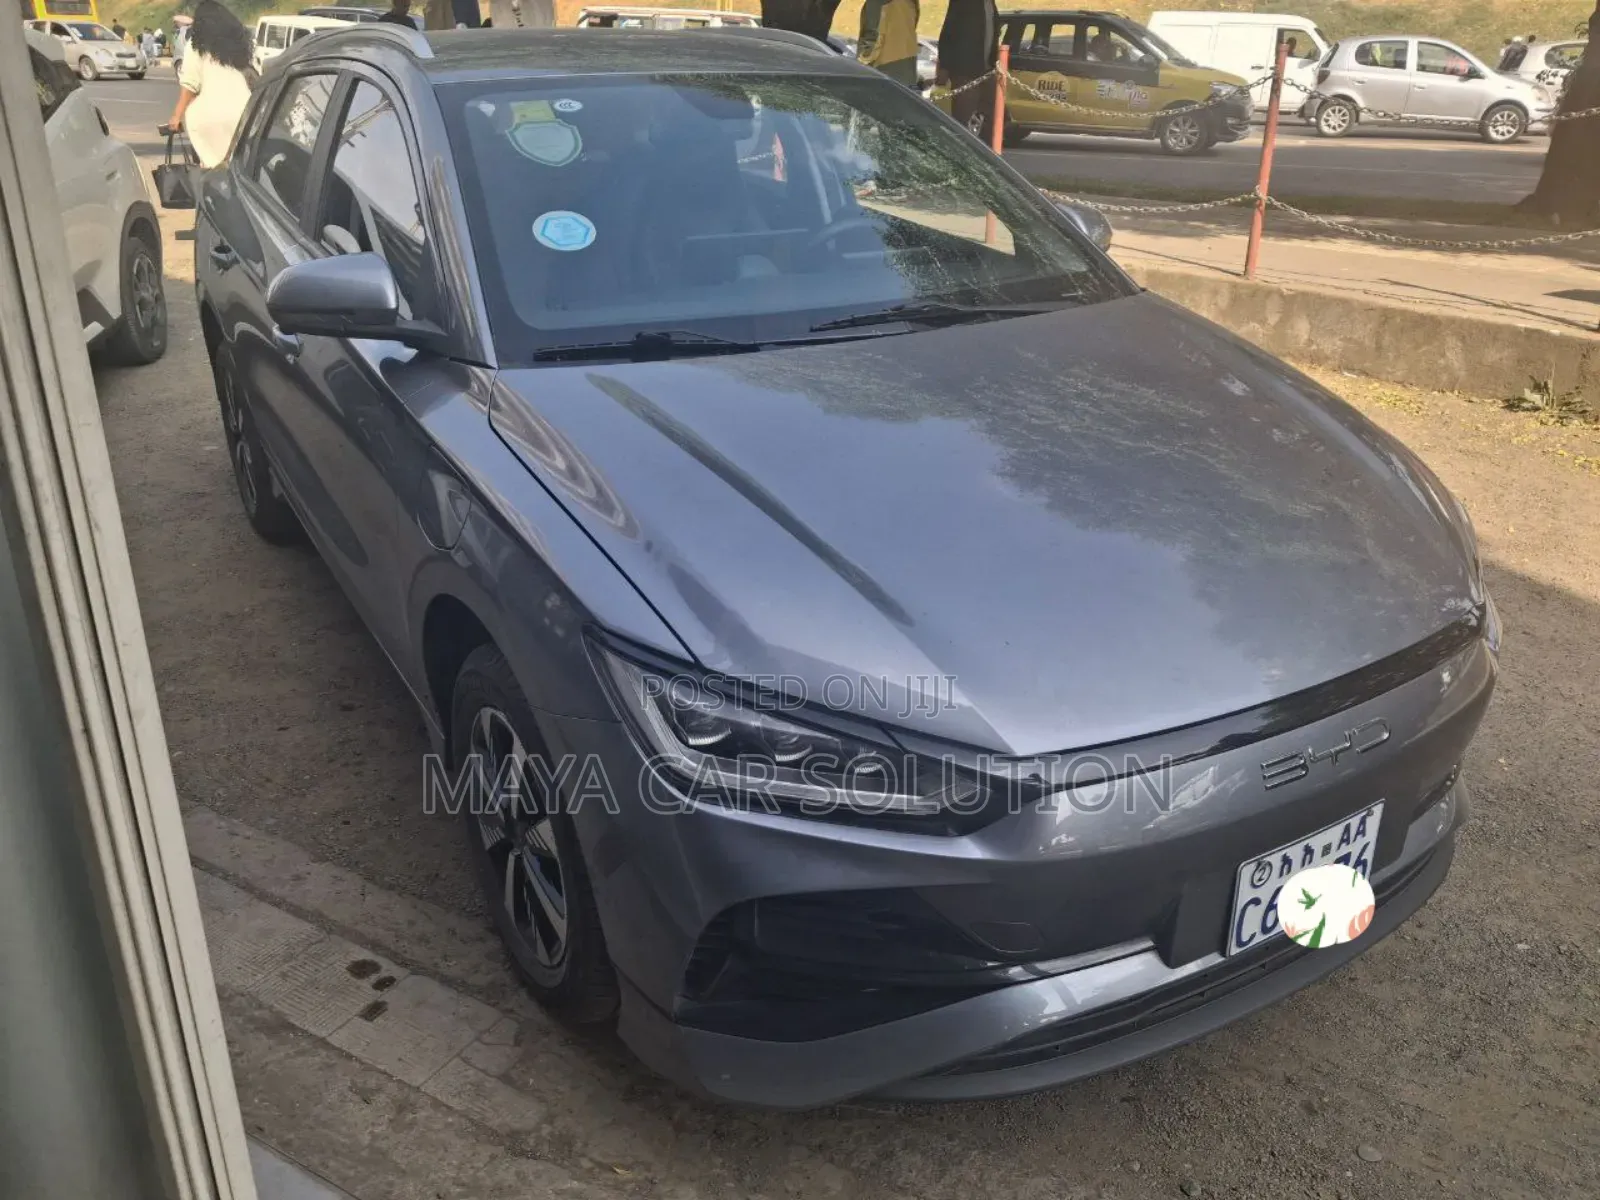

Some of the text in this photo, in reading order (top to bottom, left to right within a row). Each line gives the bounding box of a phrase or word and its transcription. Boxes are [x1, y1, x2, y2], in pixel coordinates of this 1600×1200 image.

[1038, 79, 1066, 91] RIDE
[1260, 717, 1391, 791] BYD
[1337, 814, 1367, 850] AA
